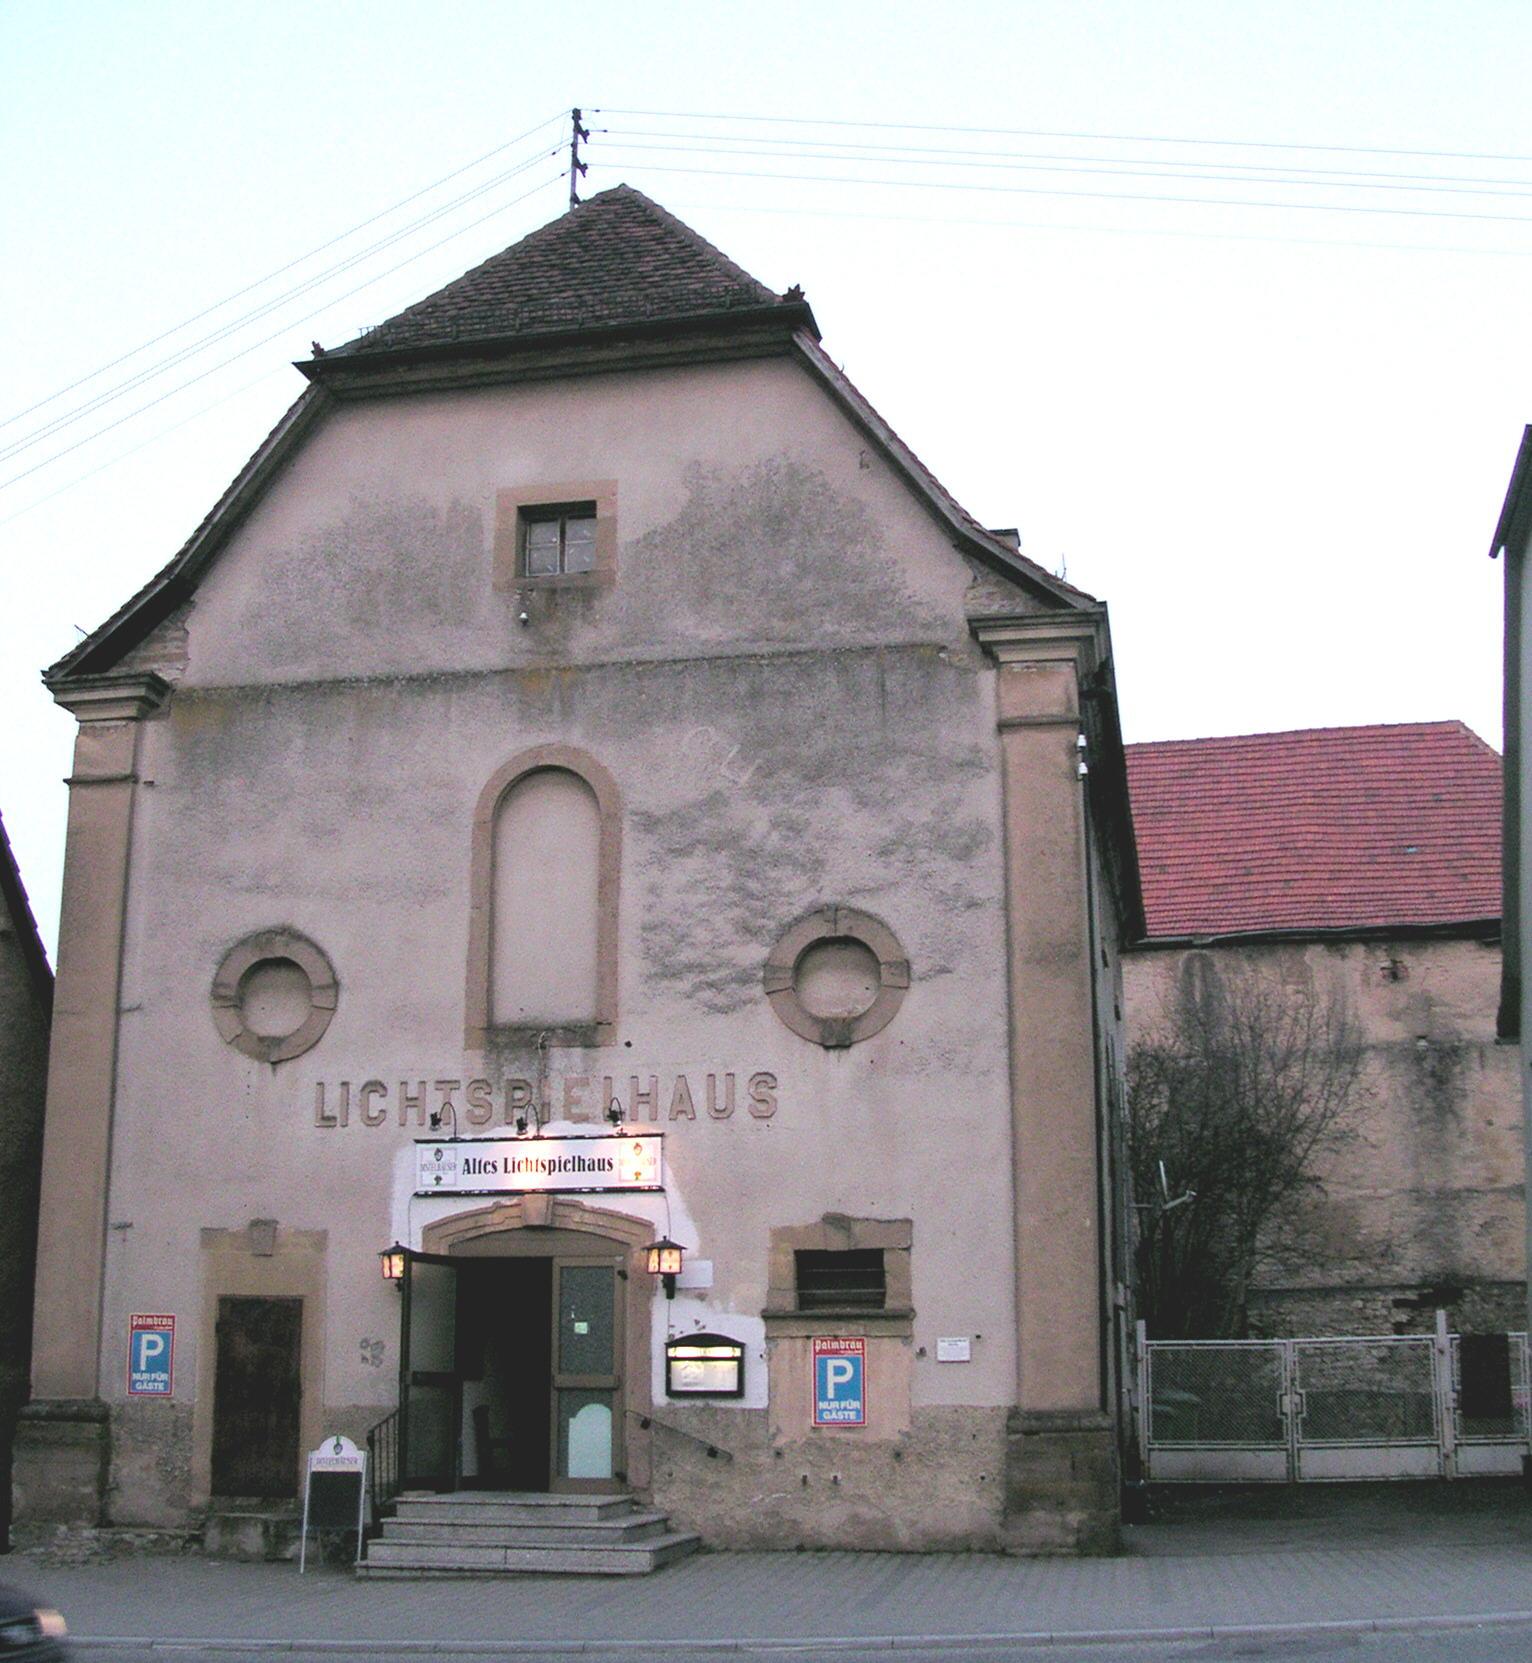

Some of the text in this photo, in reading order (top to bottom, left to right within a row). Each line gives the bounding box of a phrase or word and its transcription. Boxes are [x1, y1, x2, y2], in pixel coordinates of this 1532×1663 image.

[314, 1071, 778, 1127] LICHTSPIELHAUS
[462, 1157, 498, 1175] Altes
[503, 1155, 614, 1175] Lichtspielhaus
[140, 1334, 164, 1371] P
[151, 1372, 168, 1380] FÜR
[826, 1358, 854, 1399] P
[136, 1380, 164, 1390] GÄSTE
[818, 1398, 860, 1410] NUR FÜR
[823, 1408, 857, 1420] GÄSTE
